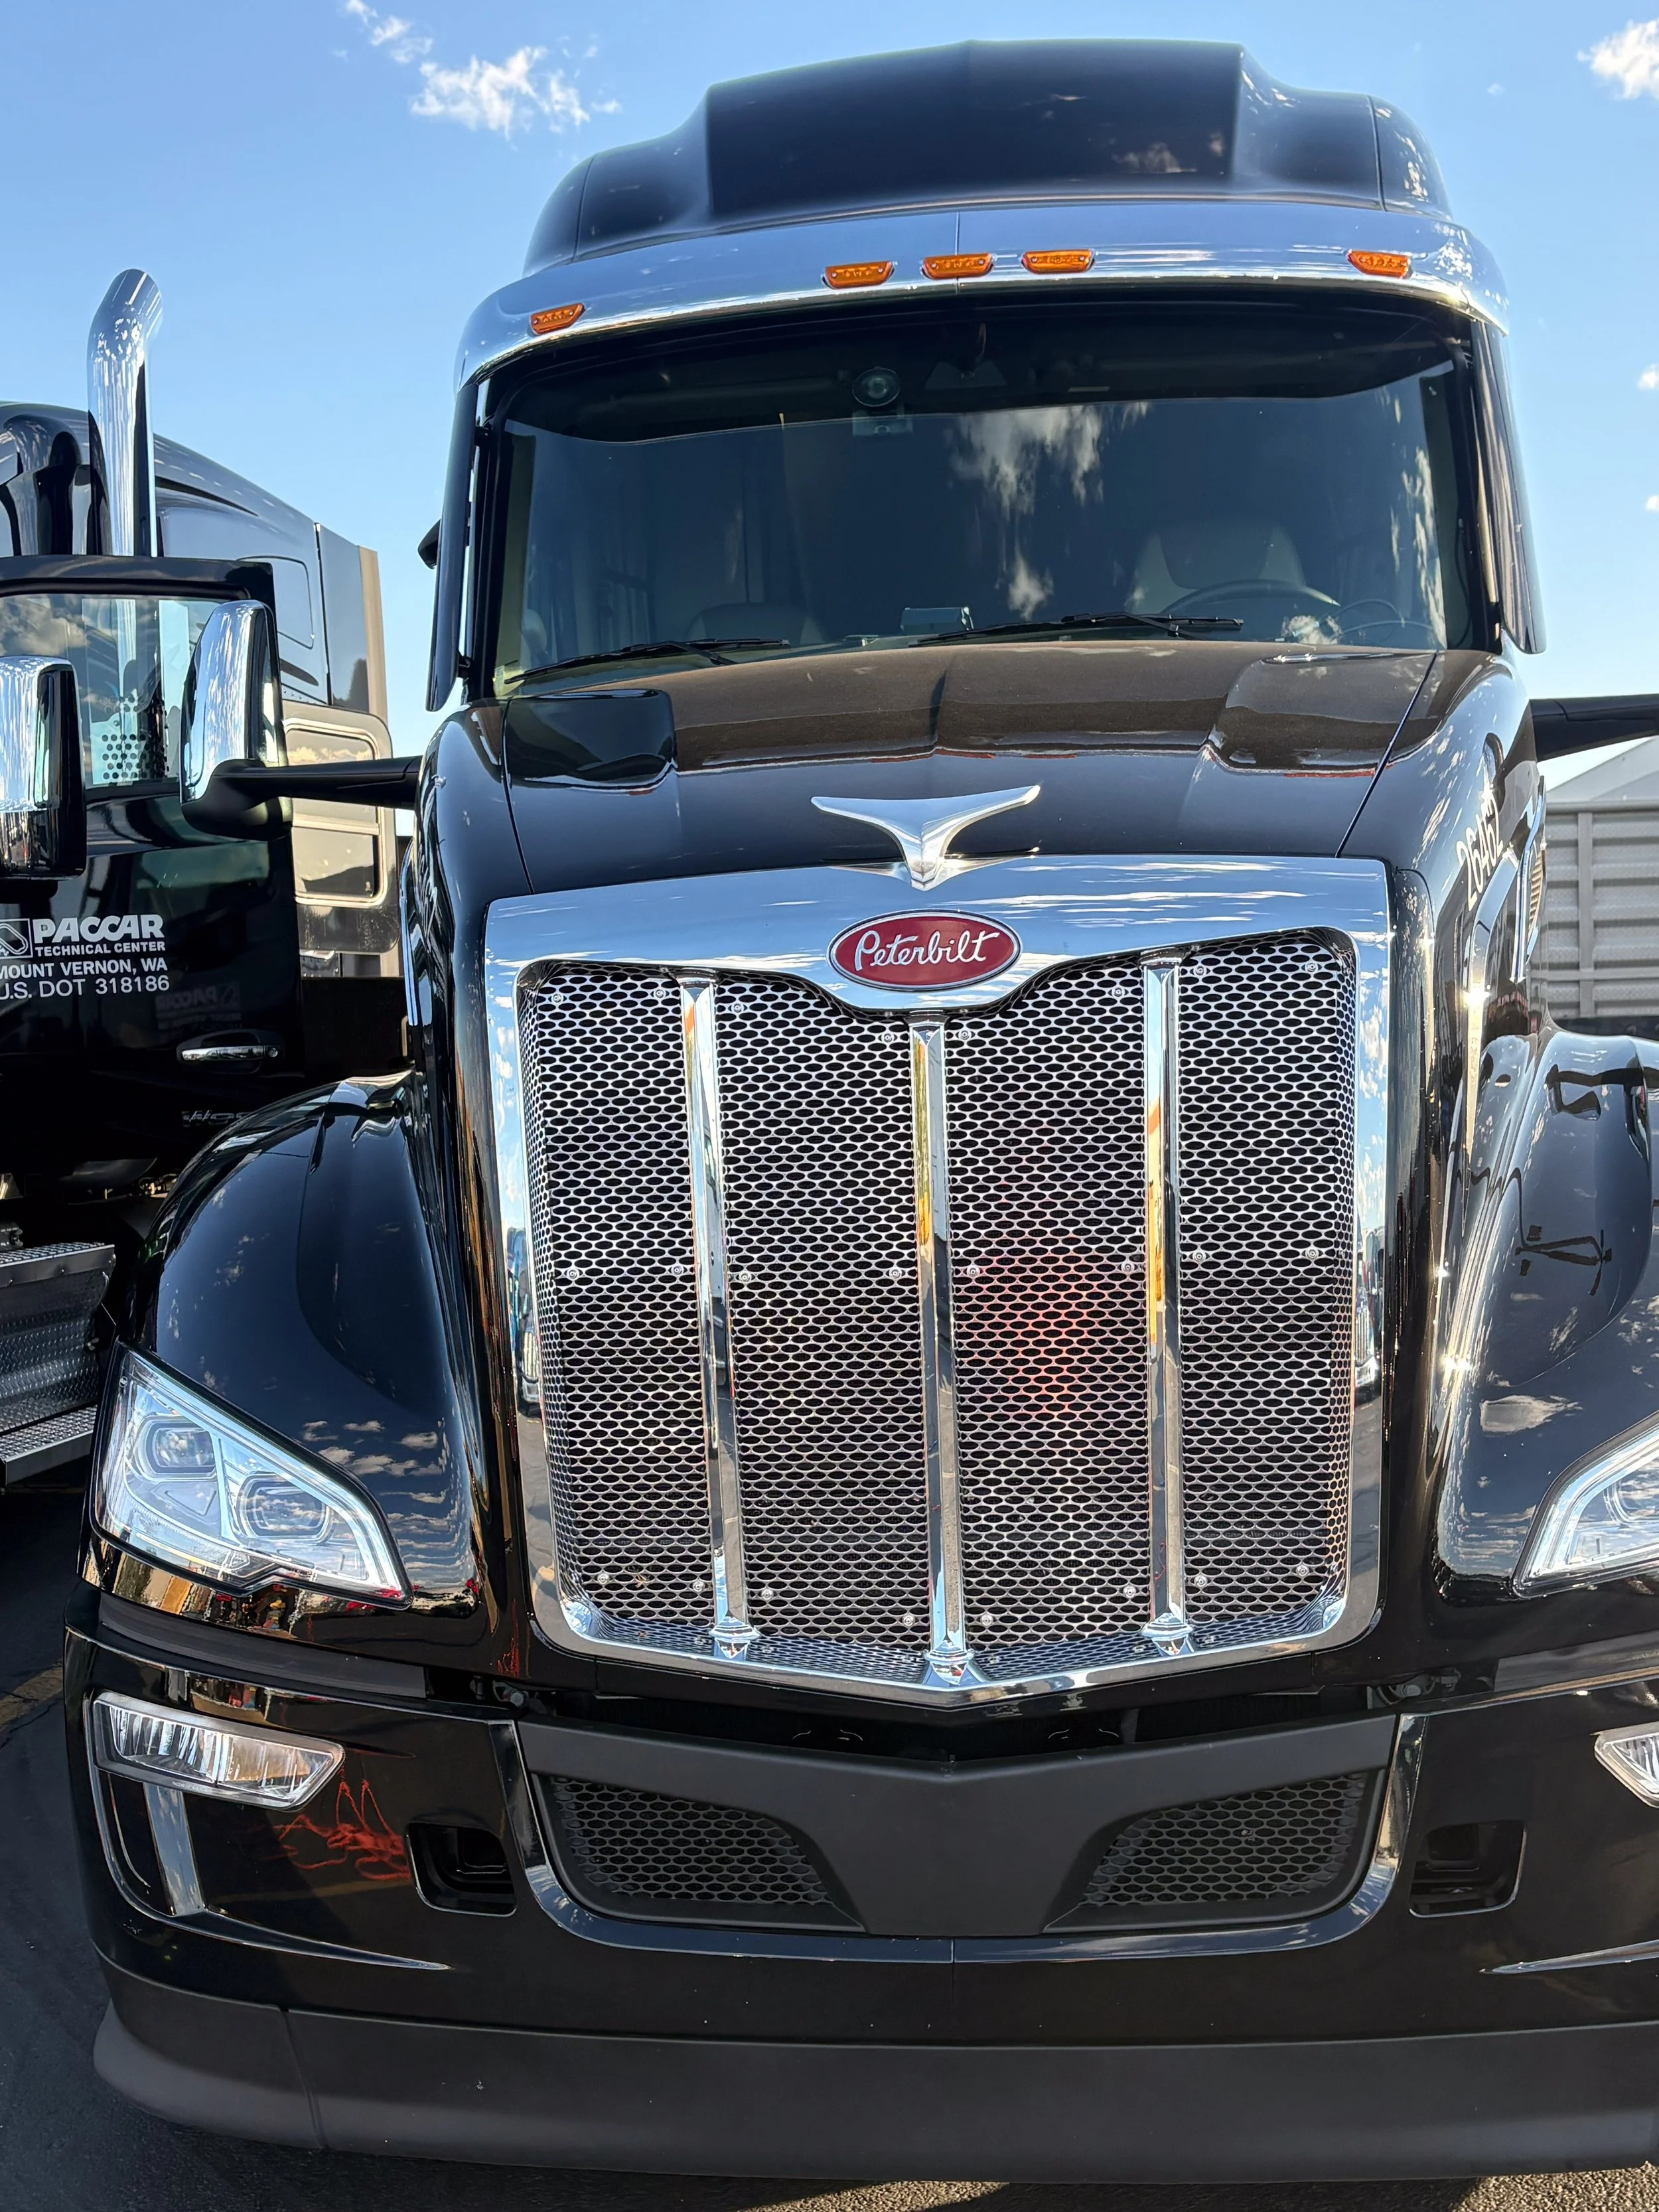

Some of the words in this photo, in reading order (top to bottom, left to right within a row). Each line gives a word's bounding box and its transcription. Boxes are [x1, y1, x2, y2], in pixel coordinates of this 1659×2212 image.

[33, 915, 165, 944] PACCAR
[35, 944, 111, 957] TECHNICAL
[113, 941, 166, 953] CENTER
[854, 930, 1000, 971] Peterbilt
[60, 958, 137, 976] VERNON,
[140, 957, 168, 972] WA
[39, 978, 86, 997] DOT
[96, 975, 170, 995] 318186
